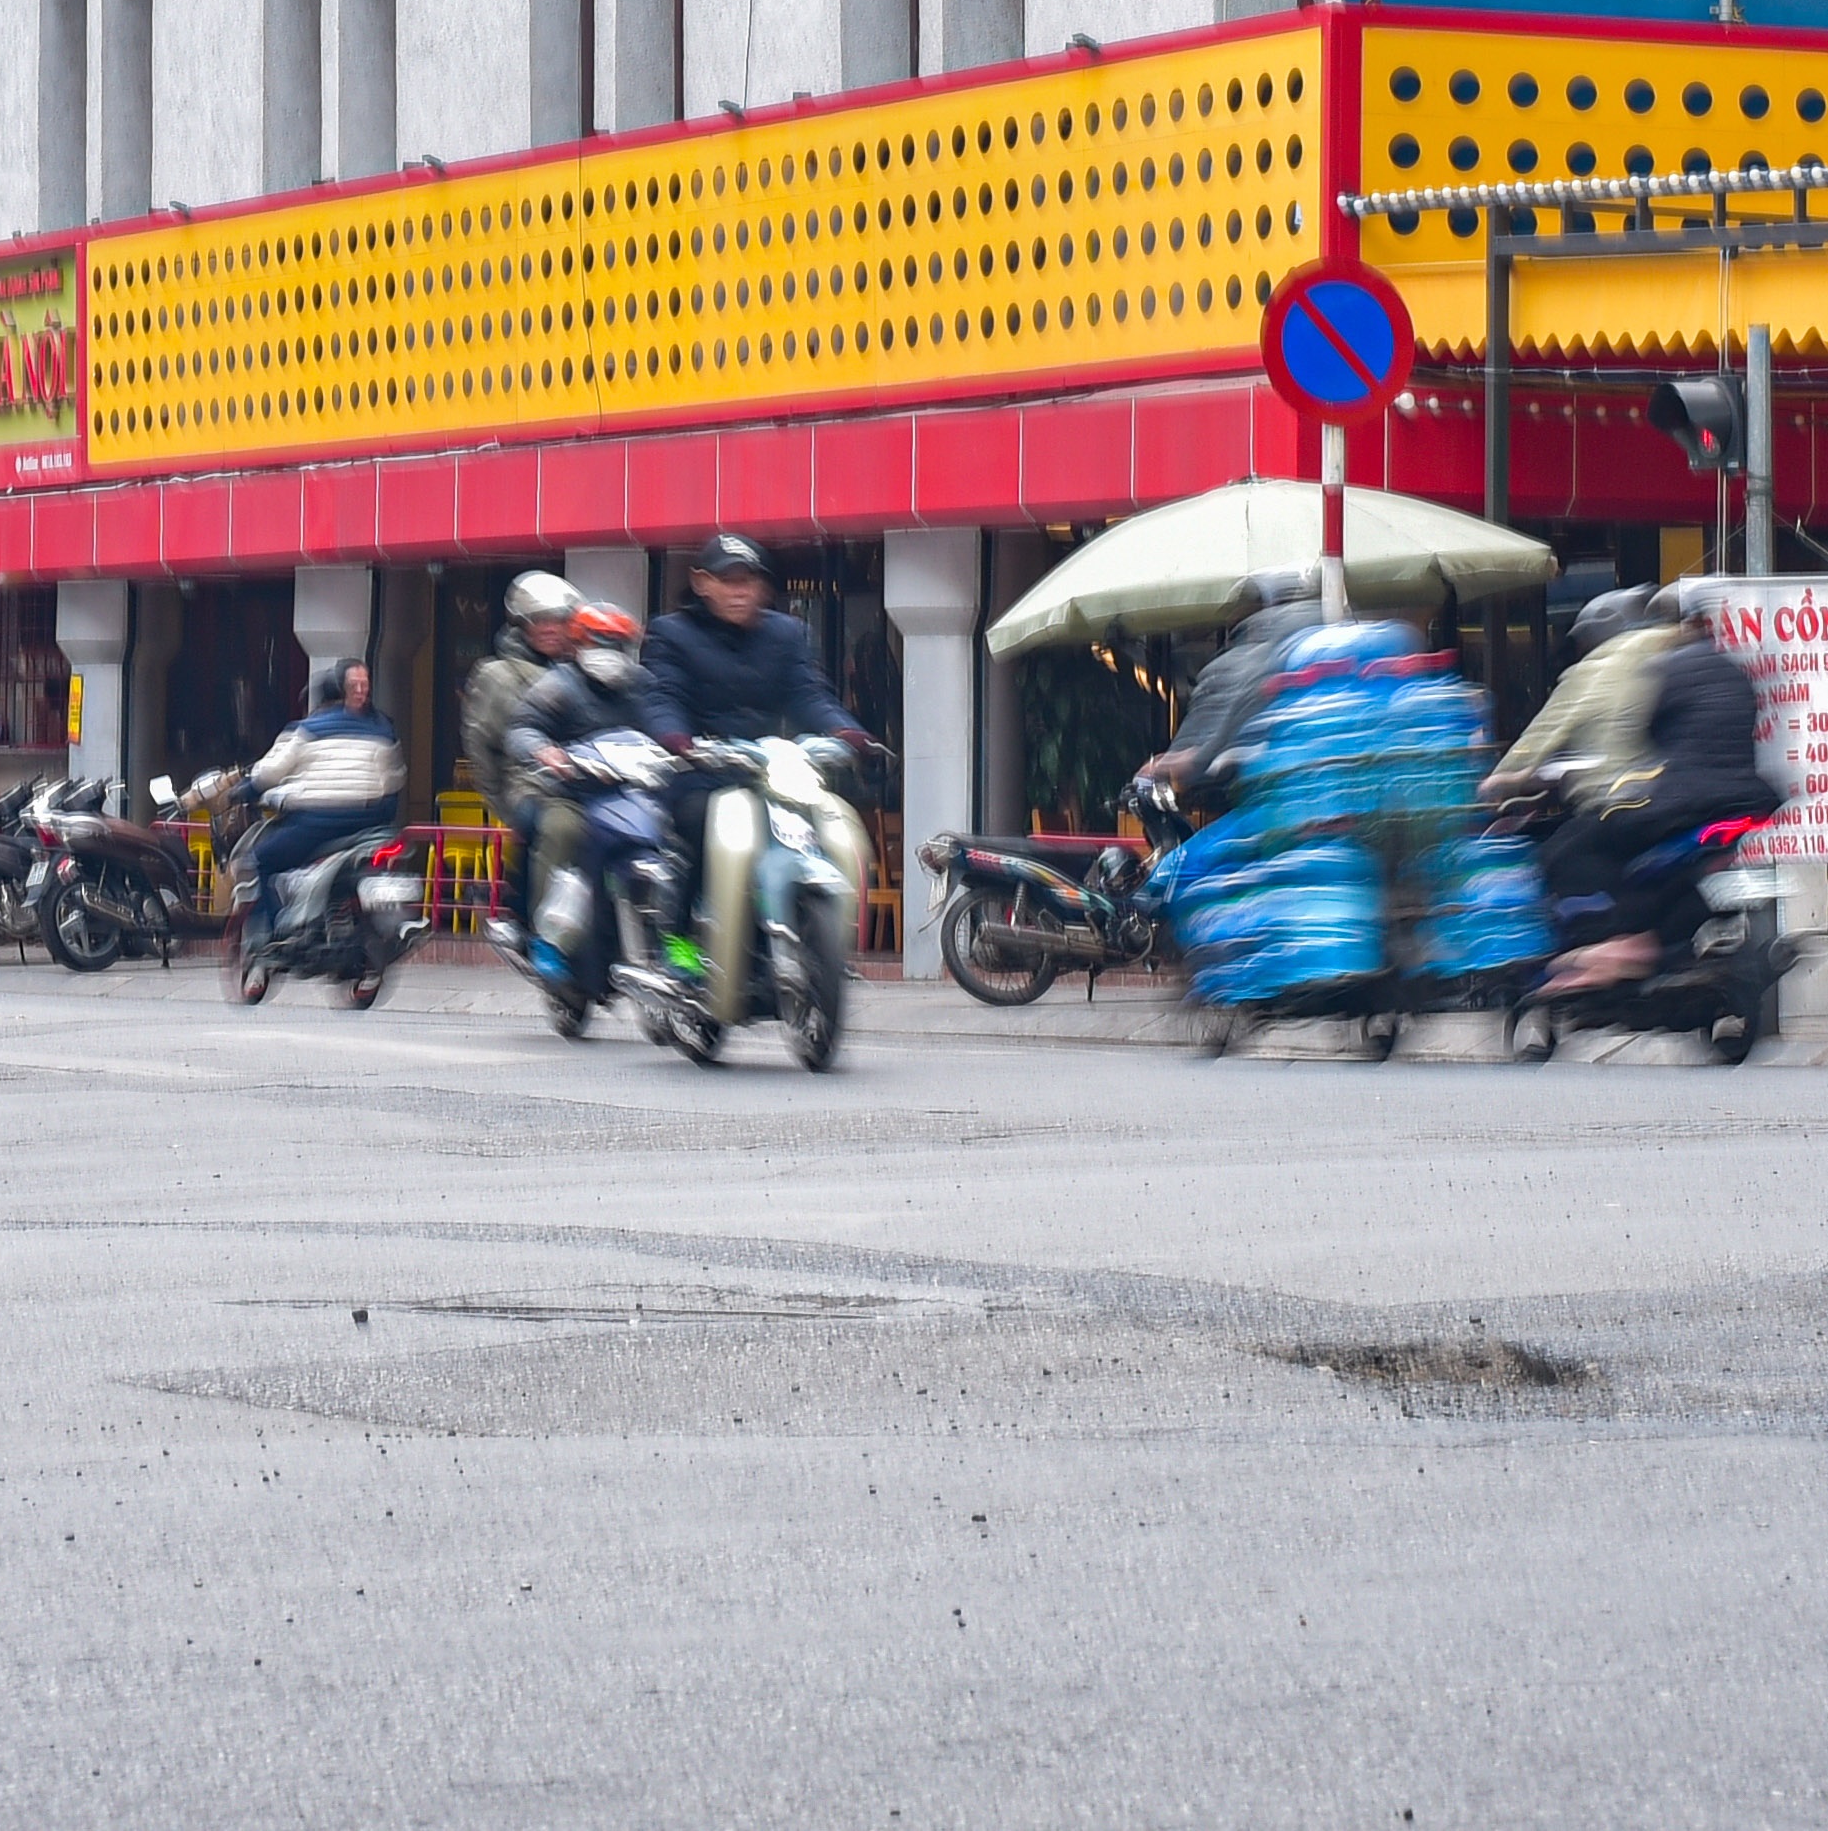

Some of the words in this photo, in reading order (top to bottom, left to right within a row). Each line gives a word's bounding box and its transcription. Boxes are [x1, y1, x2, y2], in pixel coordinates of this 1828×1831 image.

[22, 308, 67, 421] NỘI
[1780, 652, 1819, 676] SẠCH
[1768, 678, 1810, 703] NGÂM
